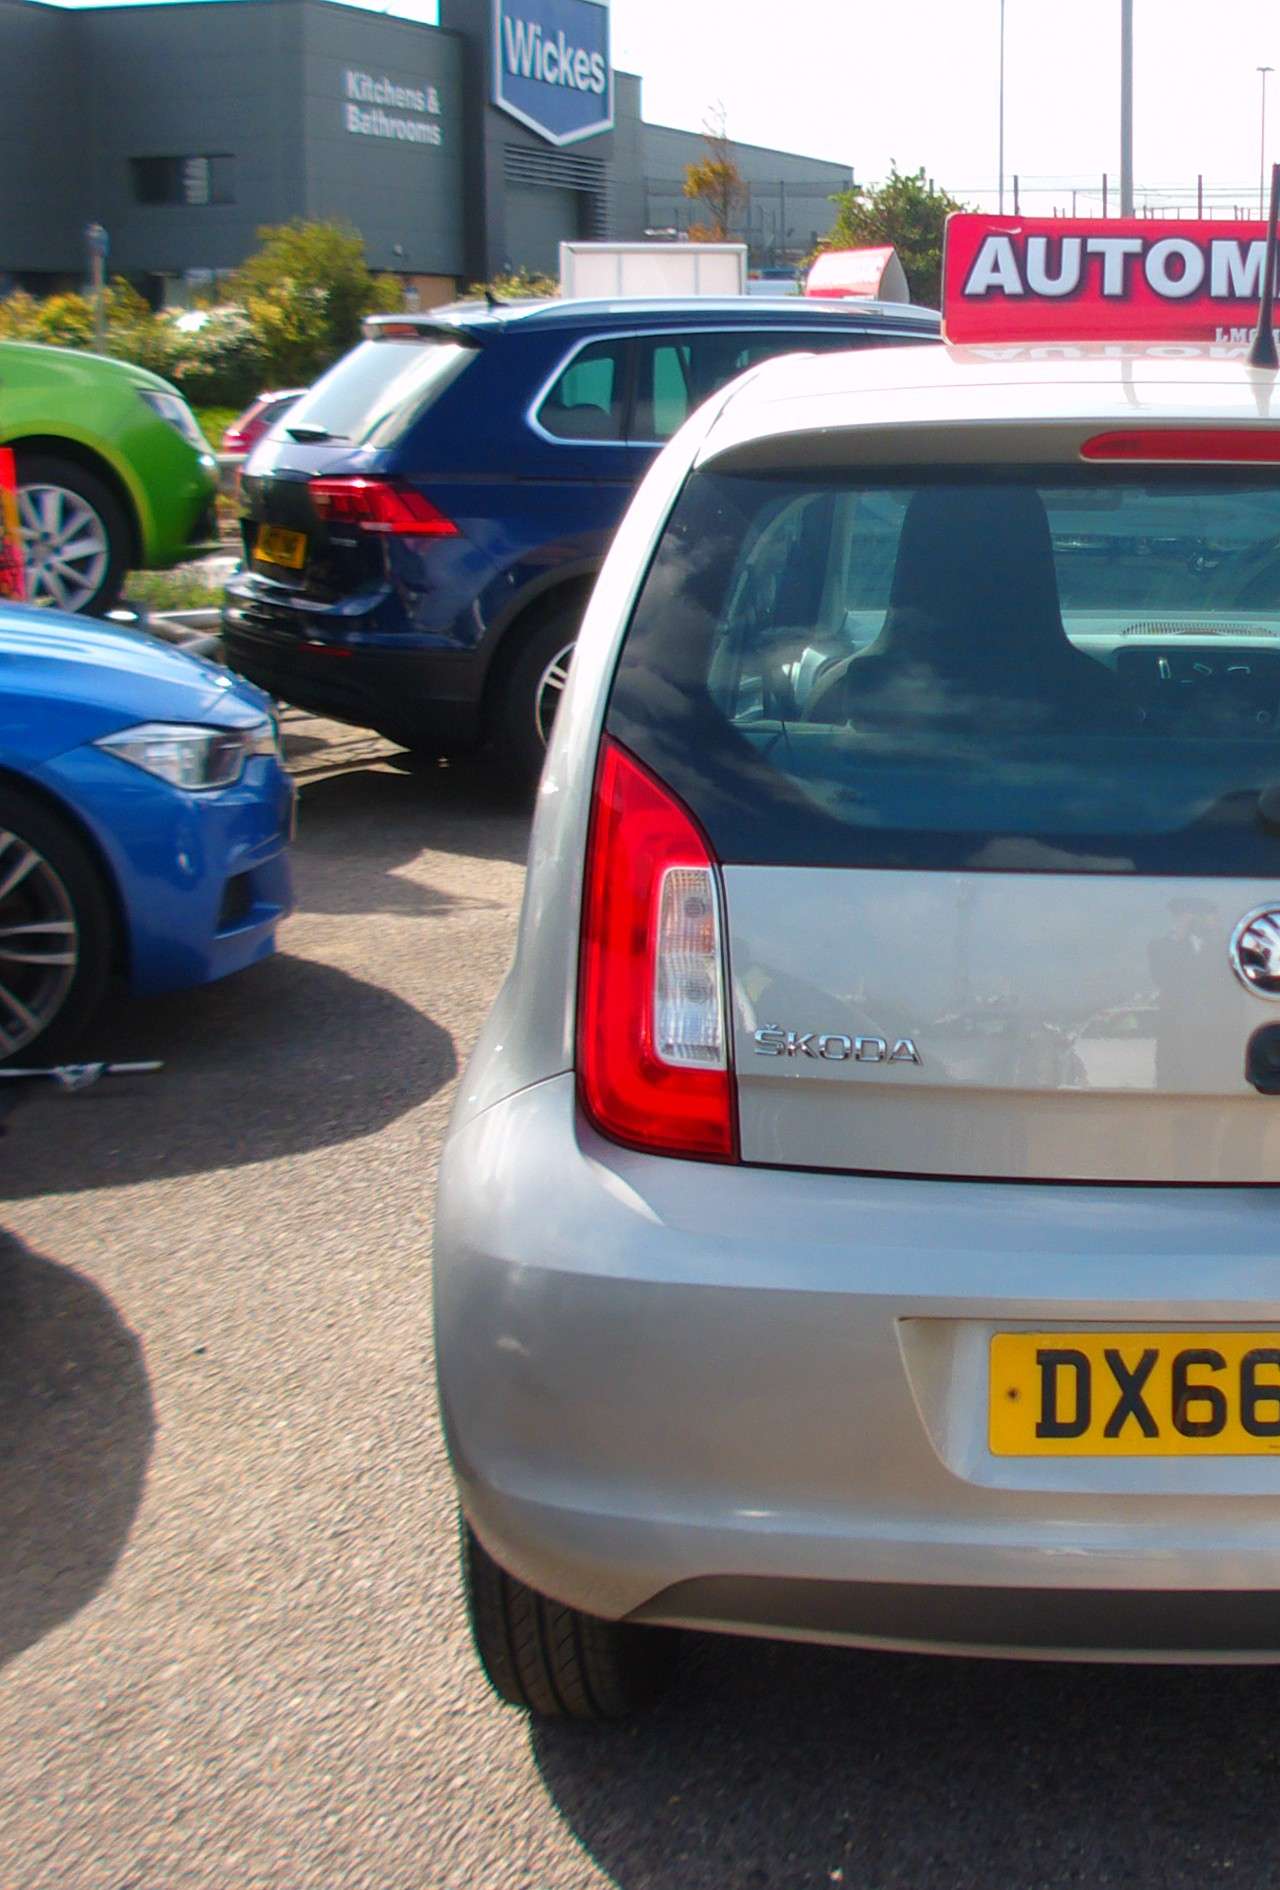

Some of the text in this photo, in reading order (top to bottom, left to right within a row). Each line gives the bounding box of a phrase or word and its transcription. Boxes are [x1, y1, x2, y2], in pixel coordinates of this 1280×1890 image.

[504, 16, 606, 95] Wickes
[346, 71, 440, 114] Kitchens &
[346, 102, 441, 146] Bathrooms
[753, 1023, 923, 1066] ŠKODA
